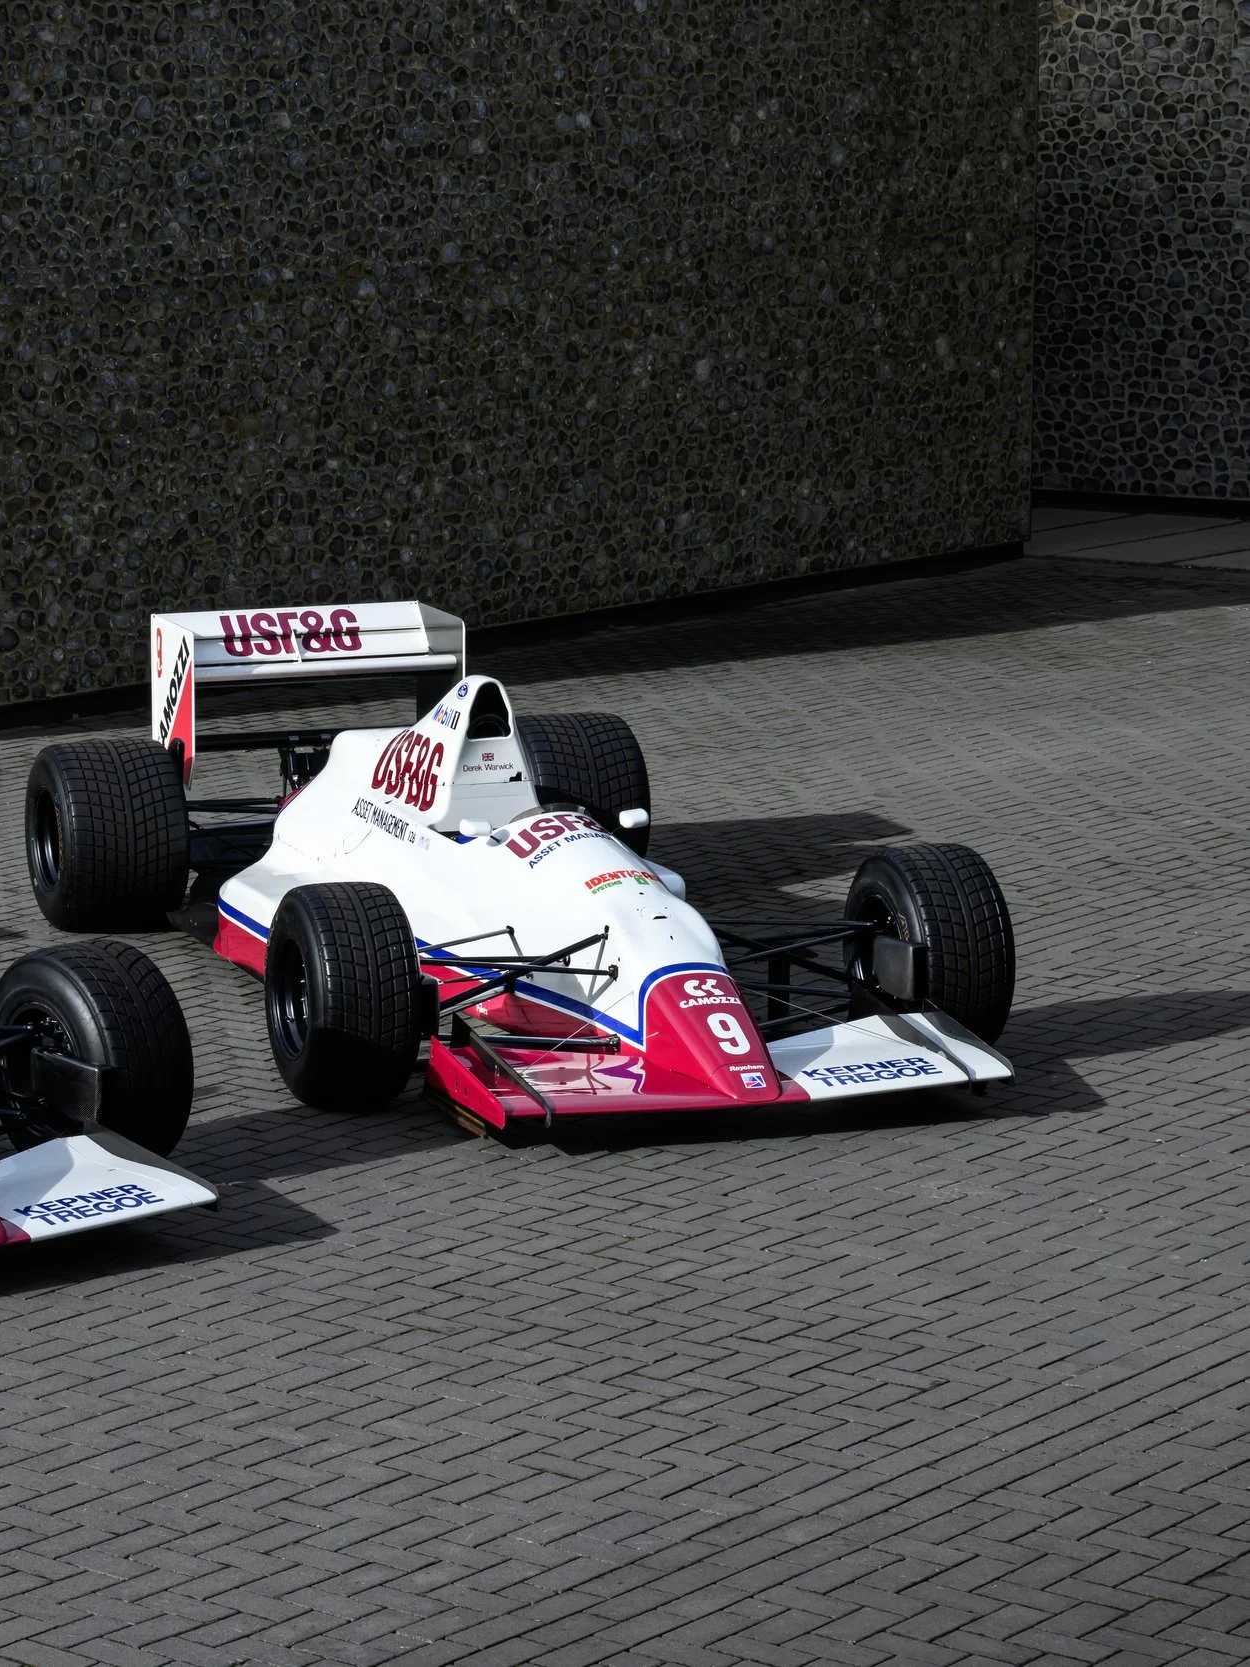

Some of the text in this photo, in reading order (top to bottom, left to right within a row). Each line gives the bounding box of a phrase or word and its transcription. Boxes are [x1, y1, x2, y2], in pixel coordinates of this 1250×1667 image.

[219, 608, 362, 657] USF&G
[156, 627, 163, 679] 9
[158, 635, 190, 746] AMOZZI
[432, 703, 454, 728] Mobil
[371, 729, 445, 812] USF&G
[462, 762, 514, 772] Derek Warwick
[351, 797, 373, 823] ASSET
[370, 806, 410, 842] MANAGEMENT
[505, 814, 609, 859] USF&
[528, 840, 562, 869] ASSET
[591, 880, 623, 895] SYSTEMS
[706, 1012, 751, 1055] 9
[729, 1064, 765, 1072] Raychem
[801, 1057, 931, 1079] KEPNER
[812, 1064, 943, 1087] TREGOE
[13, 1184, 148, 1217] KEPNER
[30, 1191, 165, 1226] TREGOE
